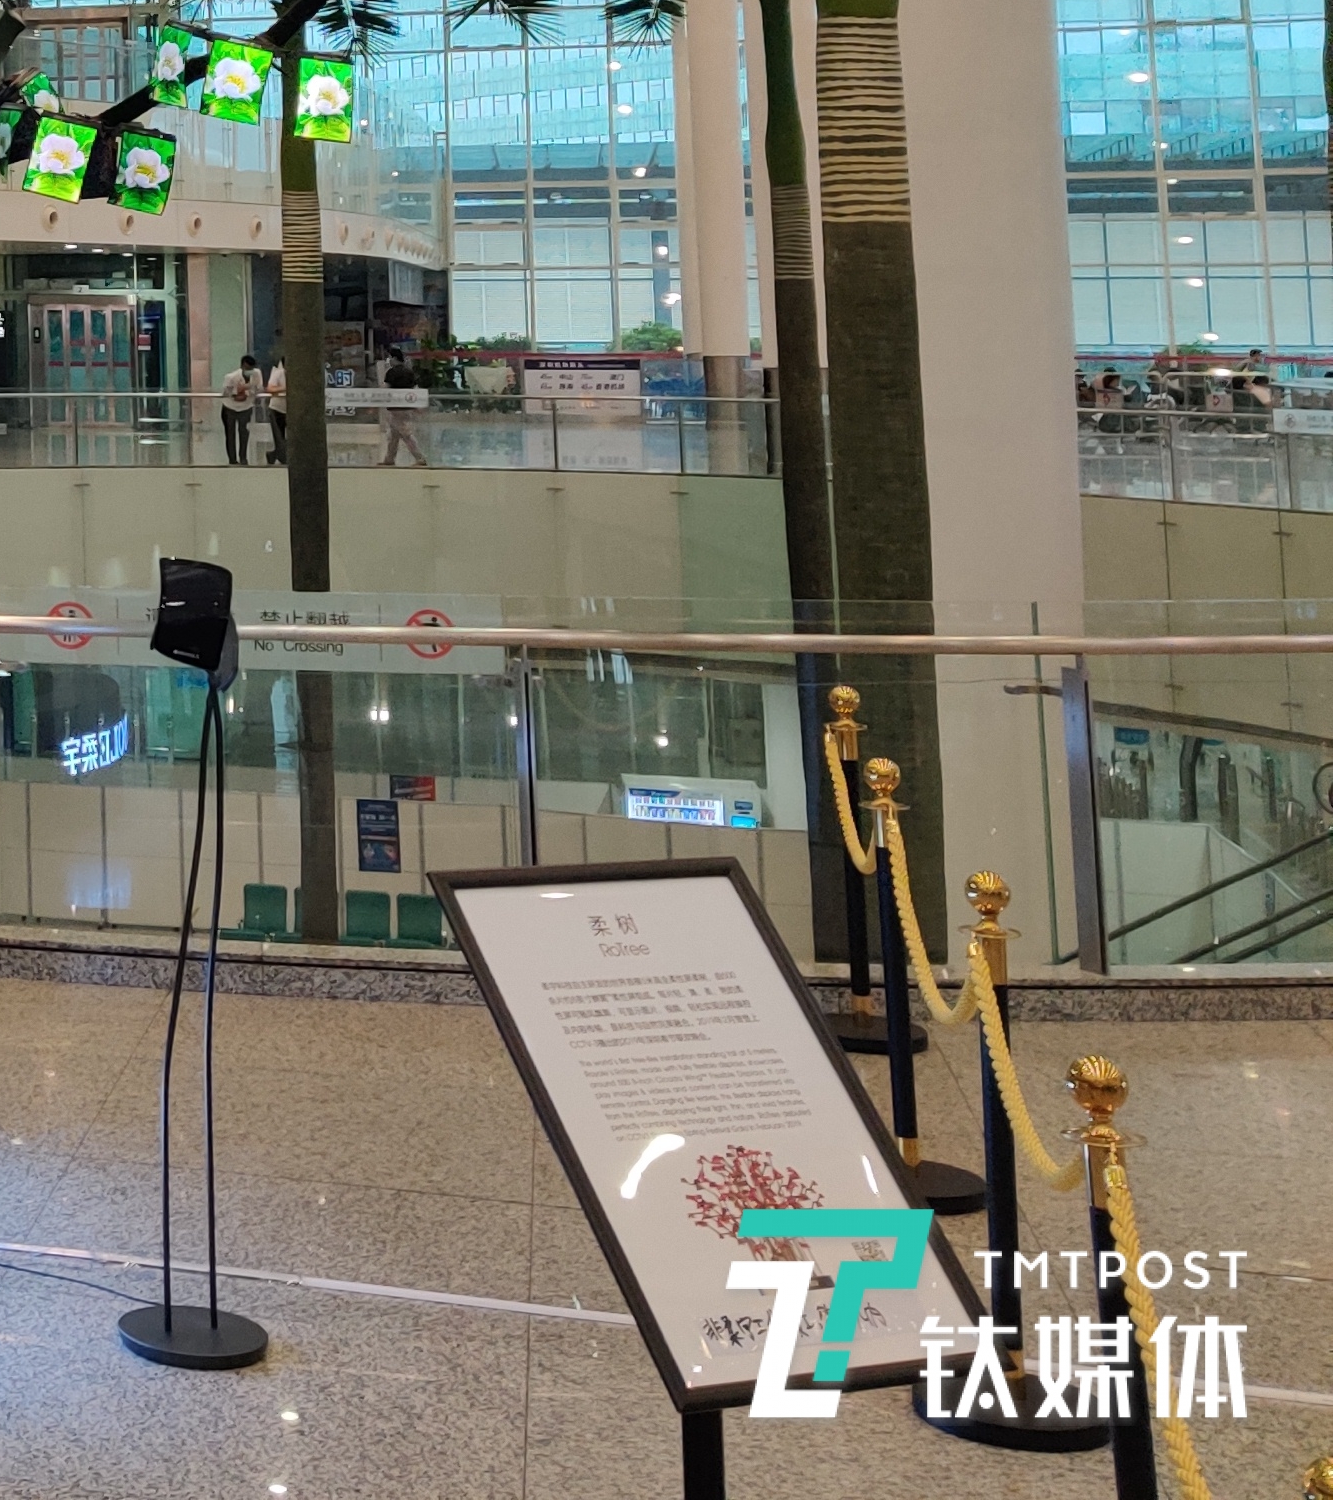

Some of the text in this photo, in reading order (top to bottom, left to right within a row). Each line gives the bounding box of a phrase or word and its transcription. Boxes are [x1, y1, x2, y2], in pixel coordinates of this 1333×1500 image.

[254, 639, 344, 656] No Crossing
[598, 942, 651, 957] RoTree
